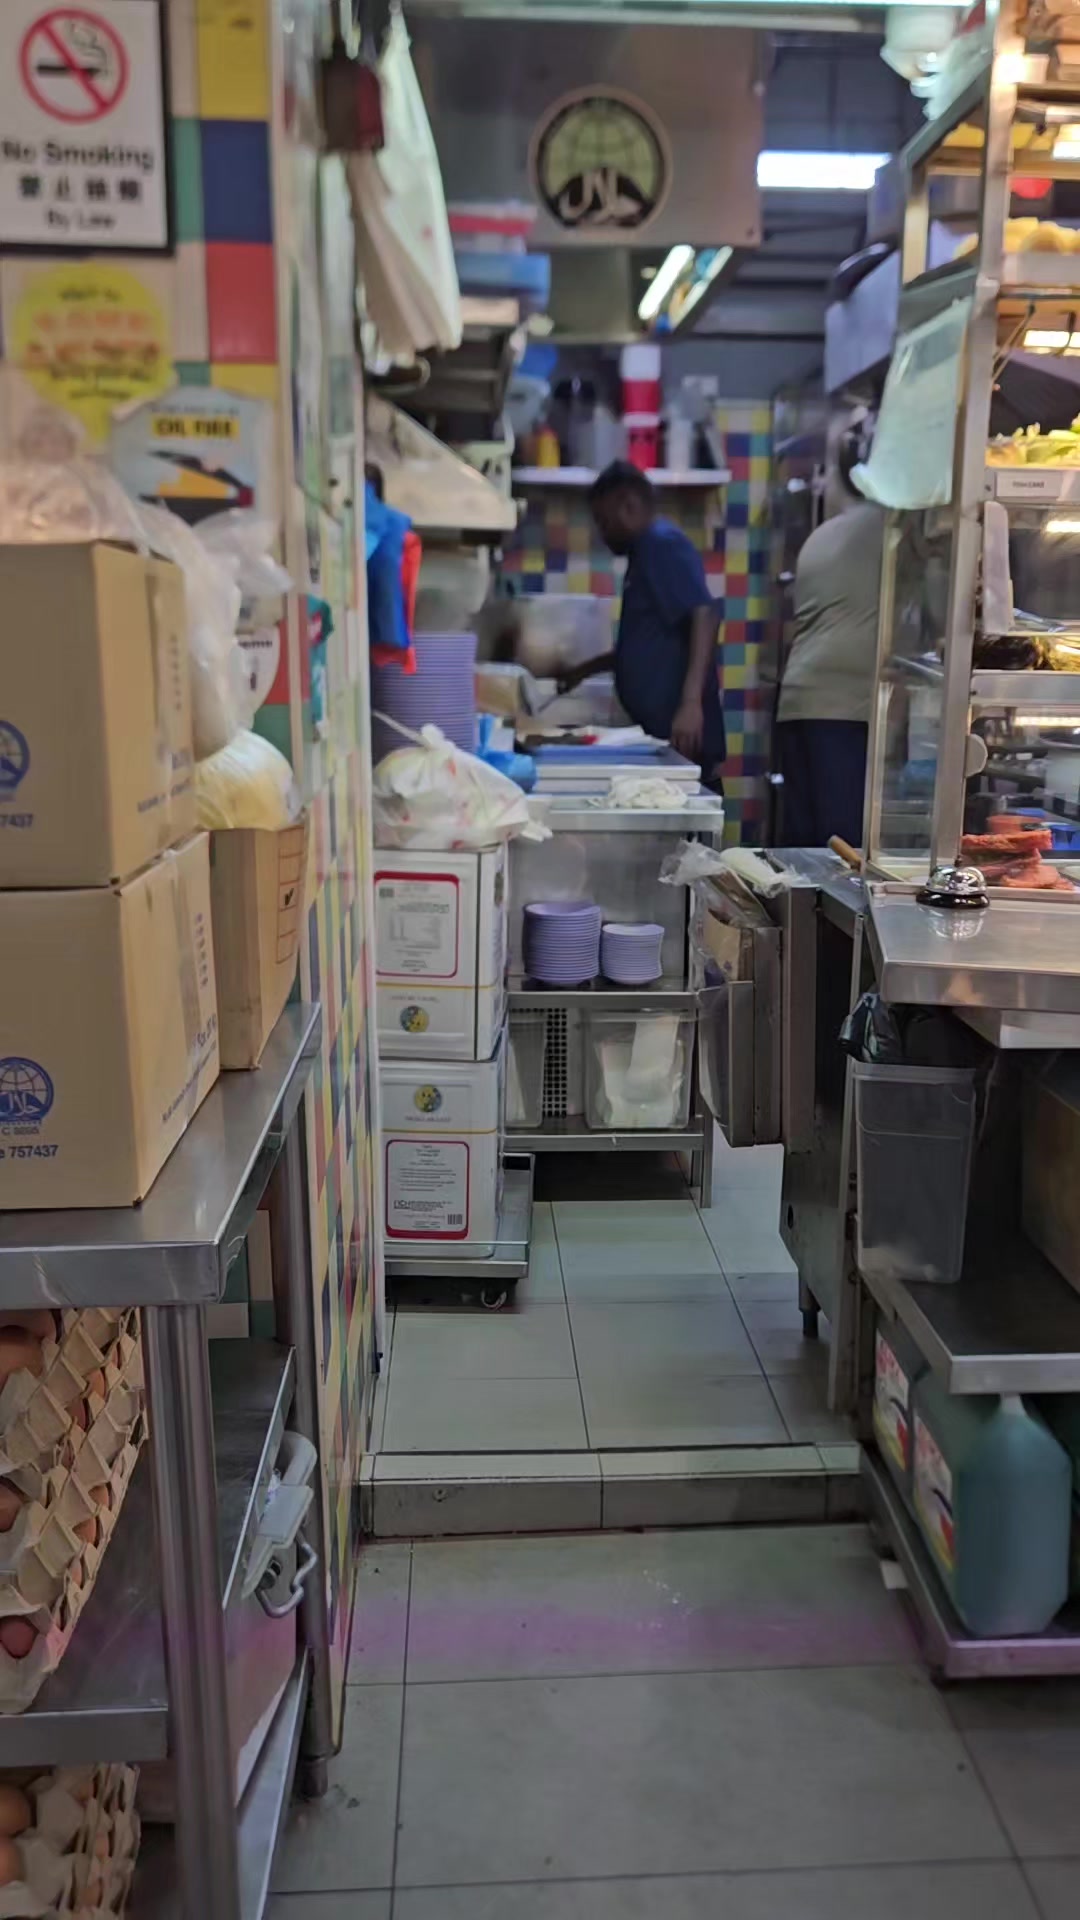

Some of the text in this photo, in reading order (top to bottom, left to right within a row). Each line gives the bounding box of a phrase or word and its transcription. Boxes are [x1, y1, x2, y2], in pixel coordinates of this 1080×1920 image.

[2, 140, 153, 174] No Smoking
[8, 1144, 59, 1158] 757437
